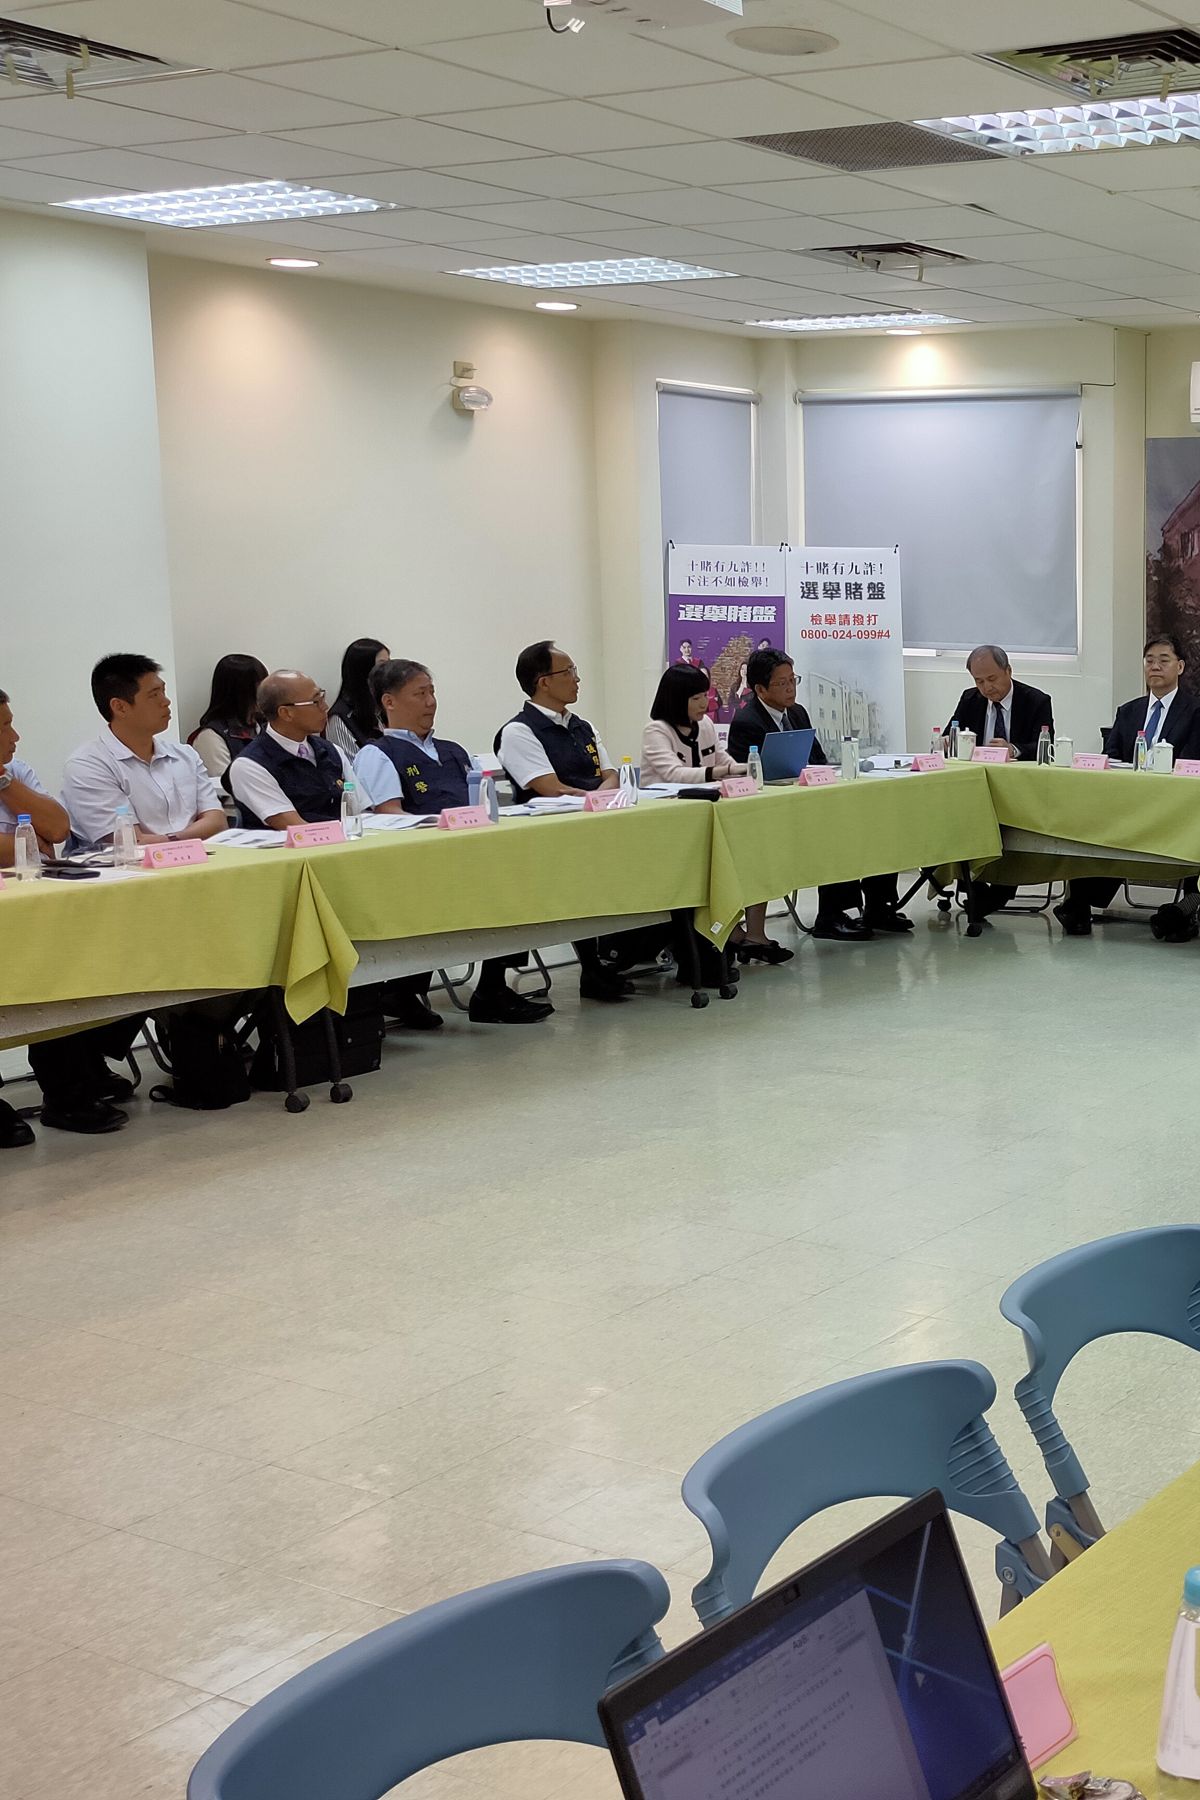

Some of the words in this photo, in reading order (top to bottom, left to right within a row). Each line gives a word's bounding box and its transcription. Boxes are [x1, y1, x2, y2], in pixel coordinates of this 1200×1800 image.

[800, 580, 886, 601] 選舉賭盤
[677, 604, 777, 623] 選舉賭盤
[810, 613, 879, 626] 檢舉請撥打
[800, 629, 891, 640] 0800-024-099#4
